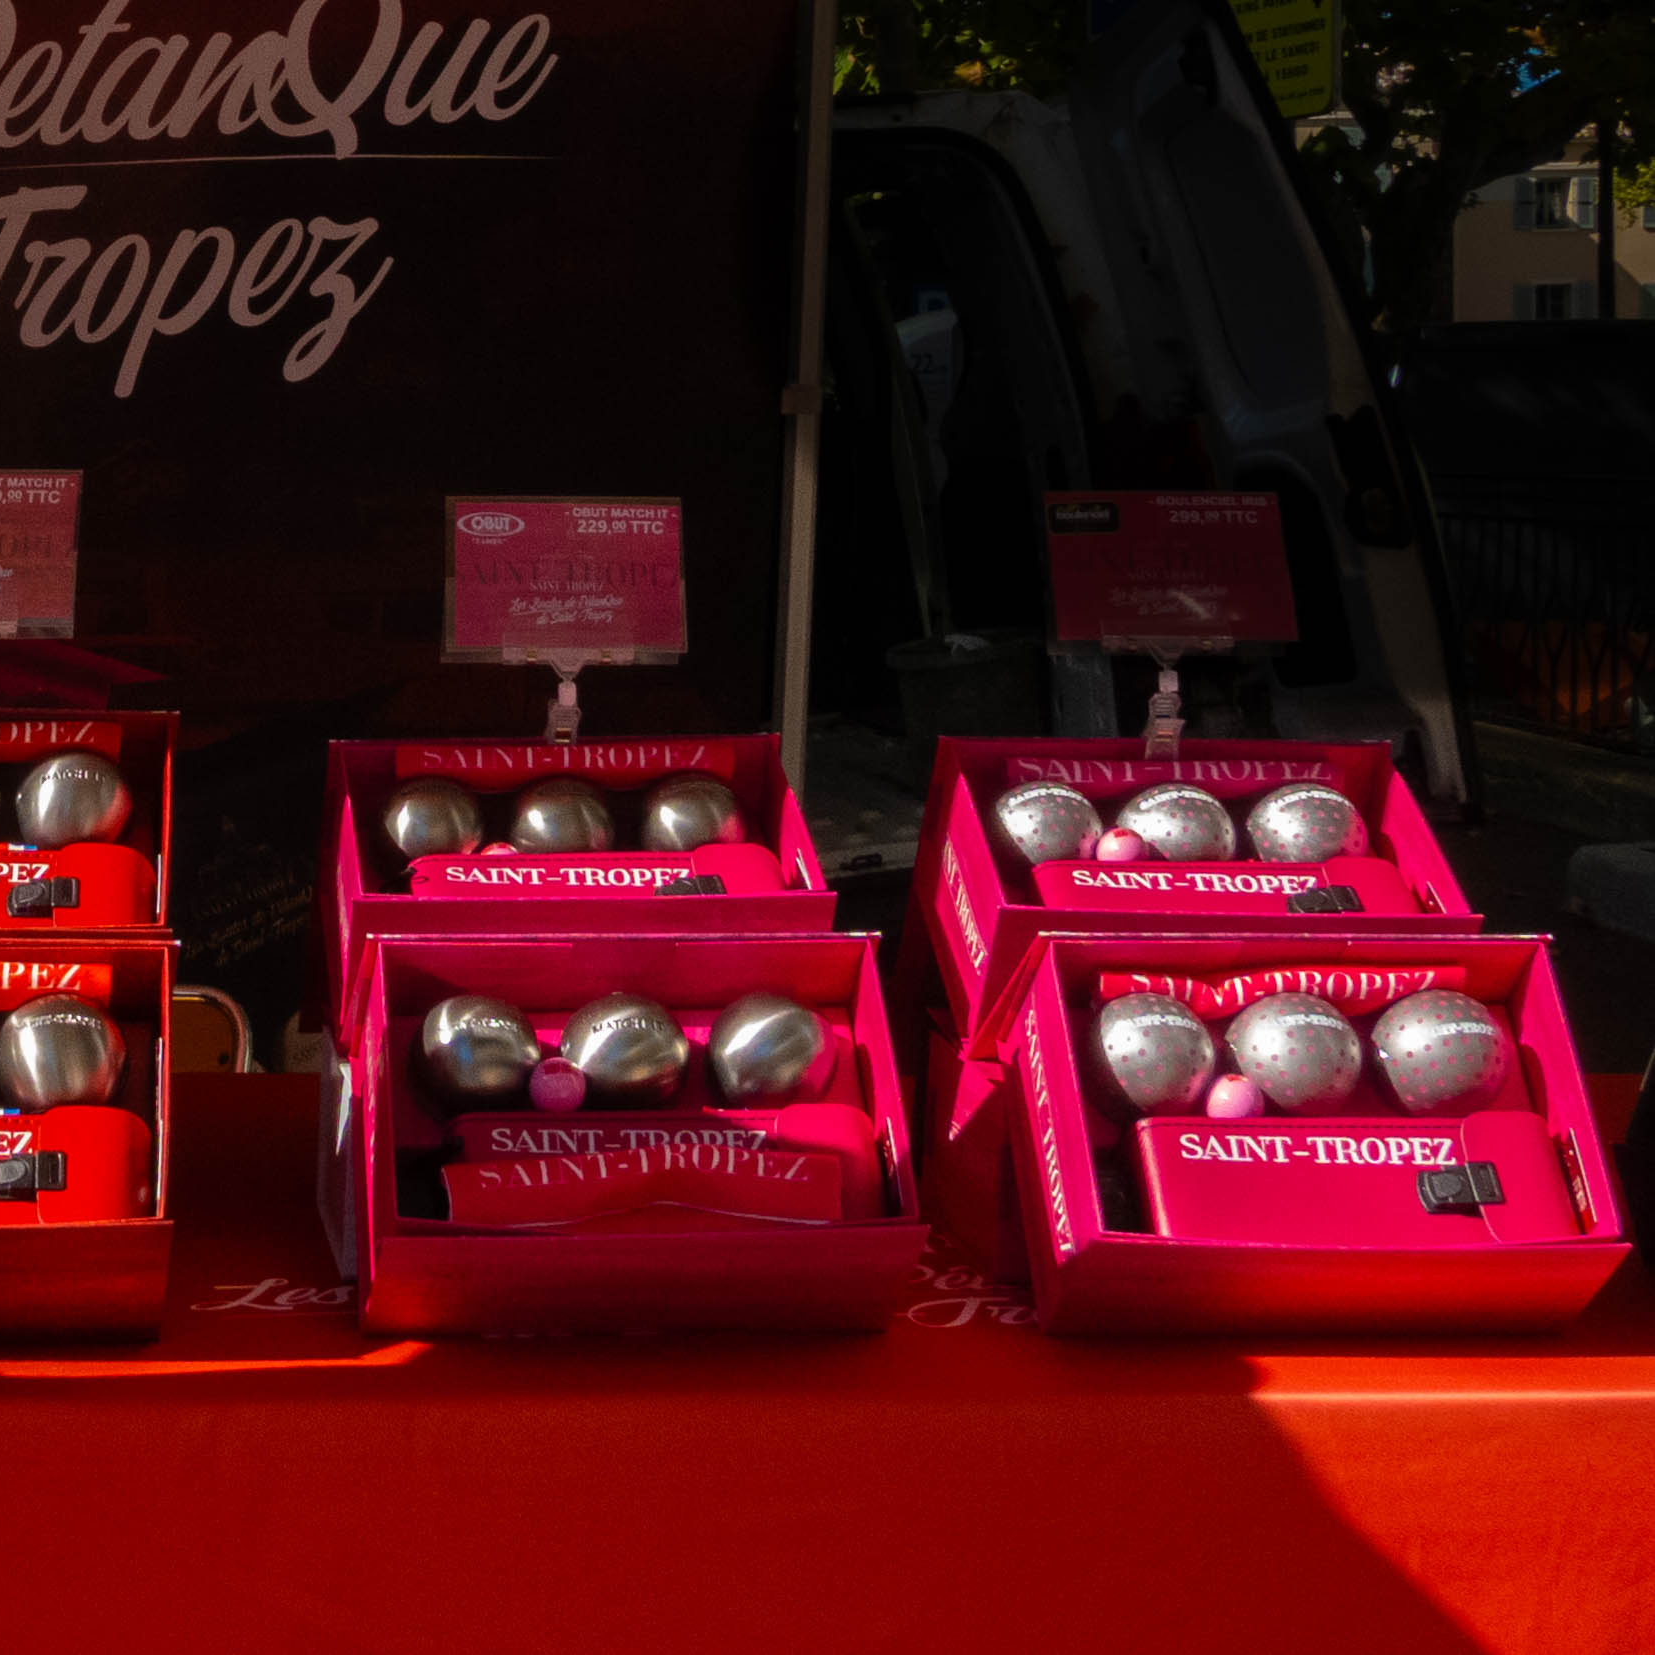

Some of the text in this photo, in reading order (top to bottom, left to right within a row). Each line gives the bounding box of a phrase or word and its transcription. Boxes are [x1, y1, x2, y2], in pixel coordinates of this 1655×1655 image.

[7, 478, 53, 488] MATCH
[55, 478, 68, 489] IT
[27, 490, 61, 504] TTC
[571, 507, 669, 519] OBUT MATCH IT
[1224, 510, 1258, 525] TTC
[470, 515, 512, 531] OBUT
[629, 520, 665, 535] TTC
[1072, 870, 1317, 895] SAINT-TROPEZ
[1179, 1132, 1457, 1166] SAINT-TROPEZ
[478, 1143, 810, 1189] SAINT-TROPEZ
